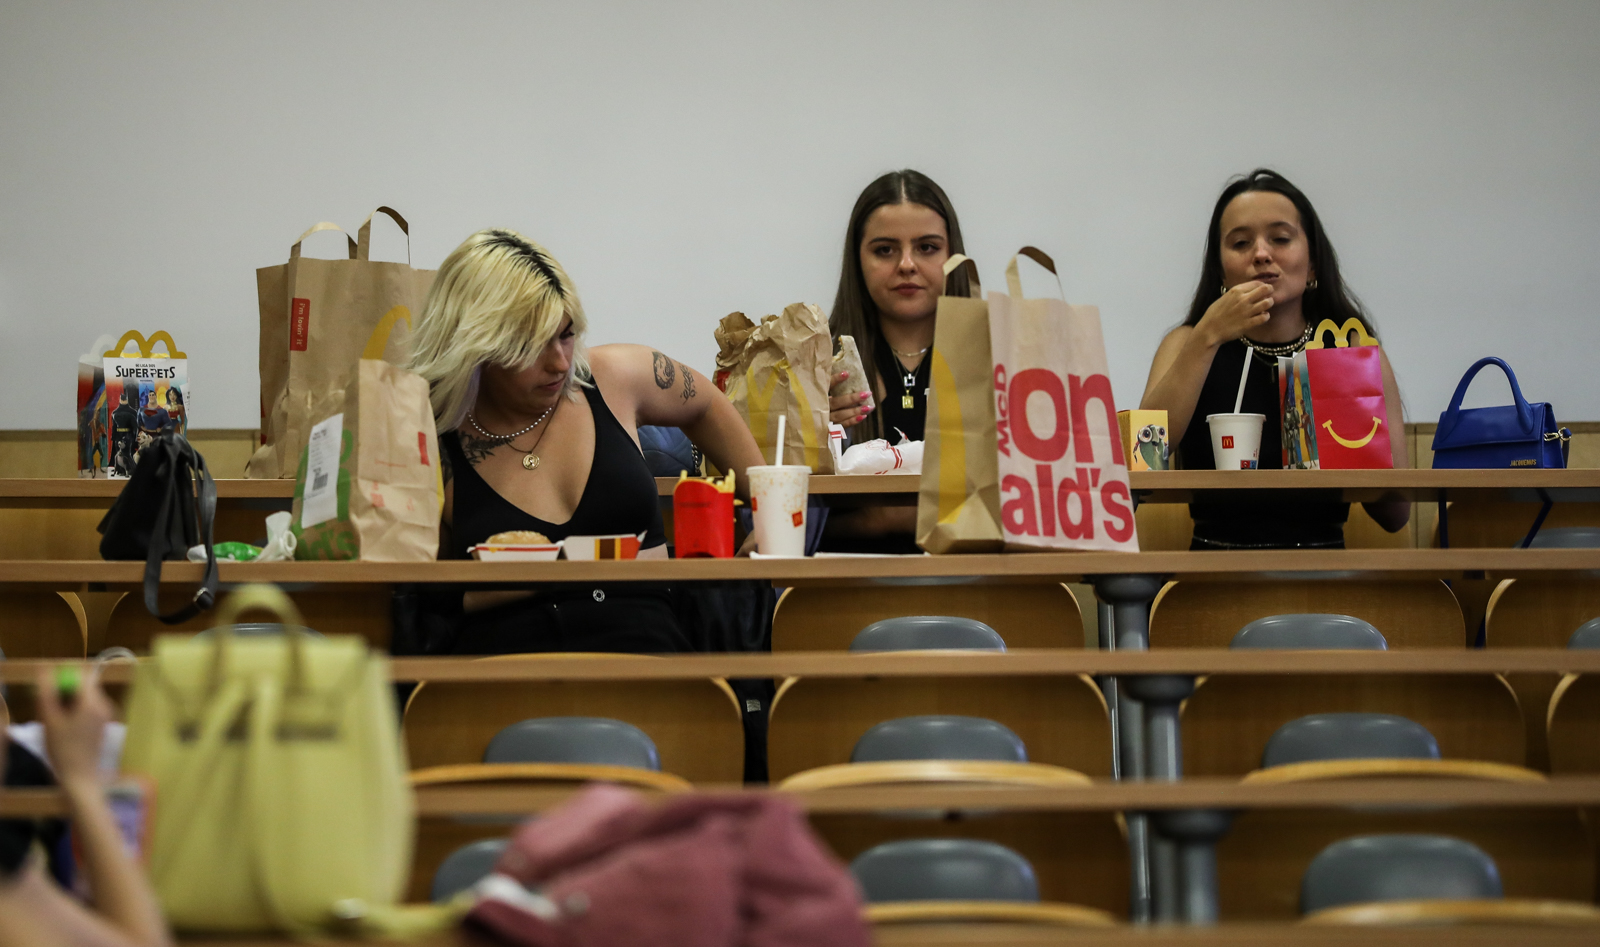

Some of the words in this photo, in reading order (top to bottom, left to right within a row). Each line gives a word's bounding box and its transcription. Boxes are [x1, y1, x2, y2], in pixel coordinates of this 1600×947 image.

[297, 316, 305, 337] lovin'
[1008, 367, 1126, 466] on
[1509, 458, 1537, 467] JACQUEMUS
[1000, 463, 1135, 543] ald's
